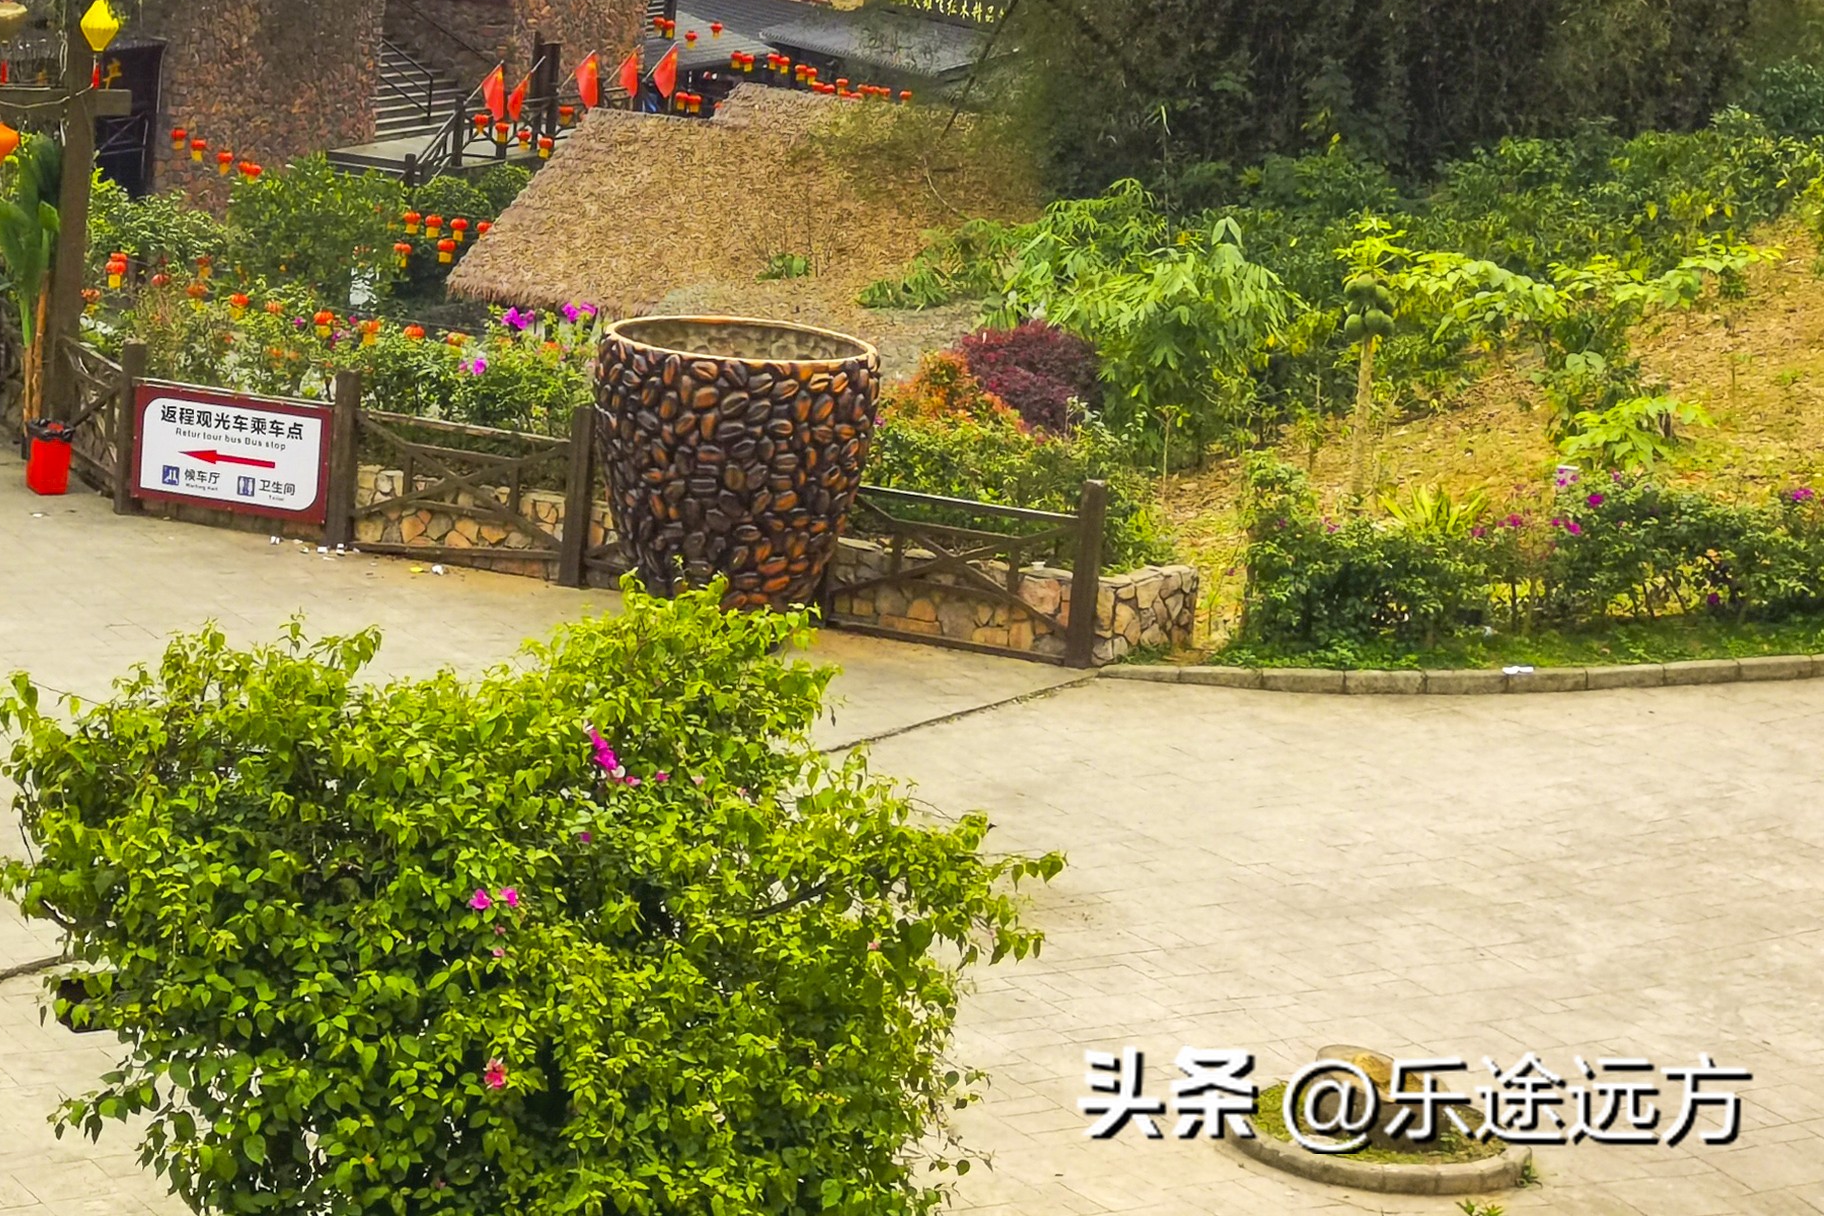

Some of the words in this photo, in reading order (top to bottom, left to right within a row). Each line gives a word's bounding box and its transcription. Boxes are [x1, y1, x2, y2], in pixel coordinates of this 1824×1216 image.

[160, 404, 304, 440] 返程观光车乘车点
[184, 469, 221, 485] 候车厅
[259, 479, 296, 496] 卫生间
